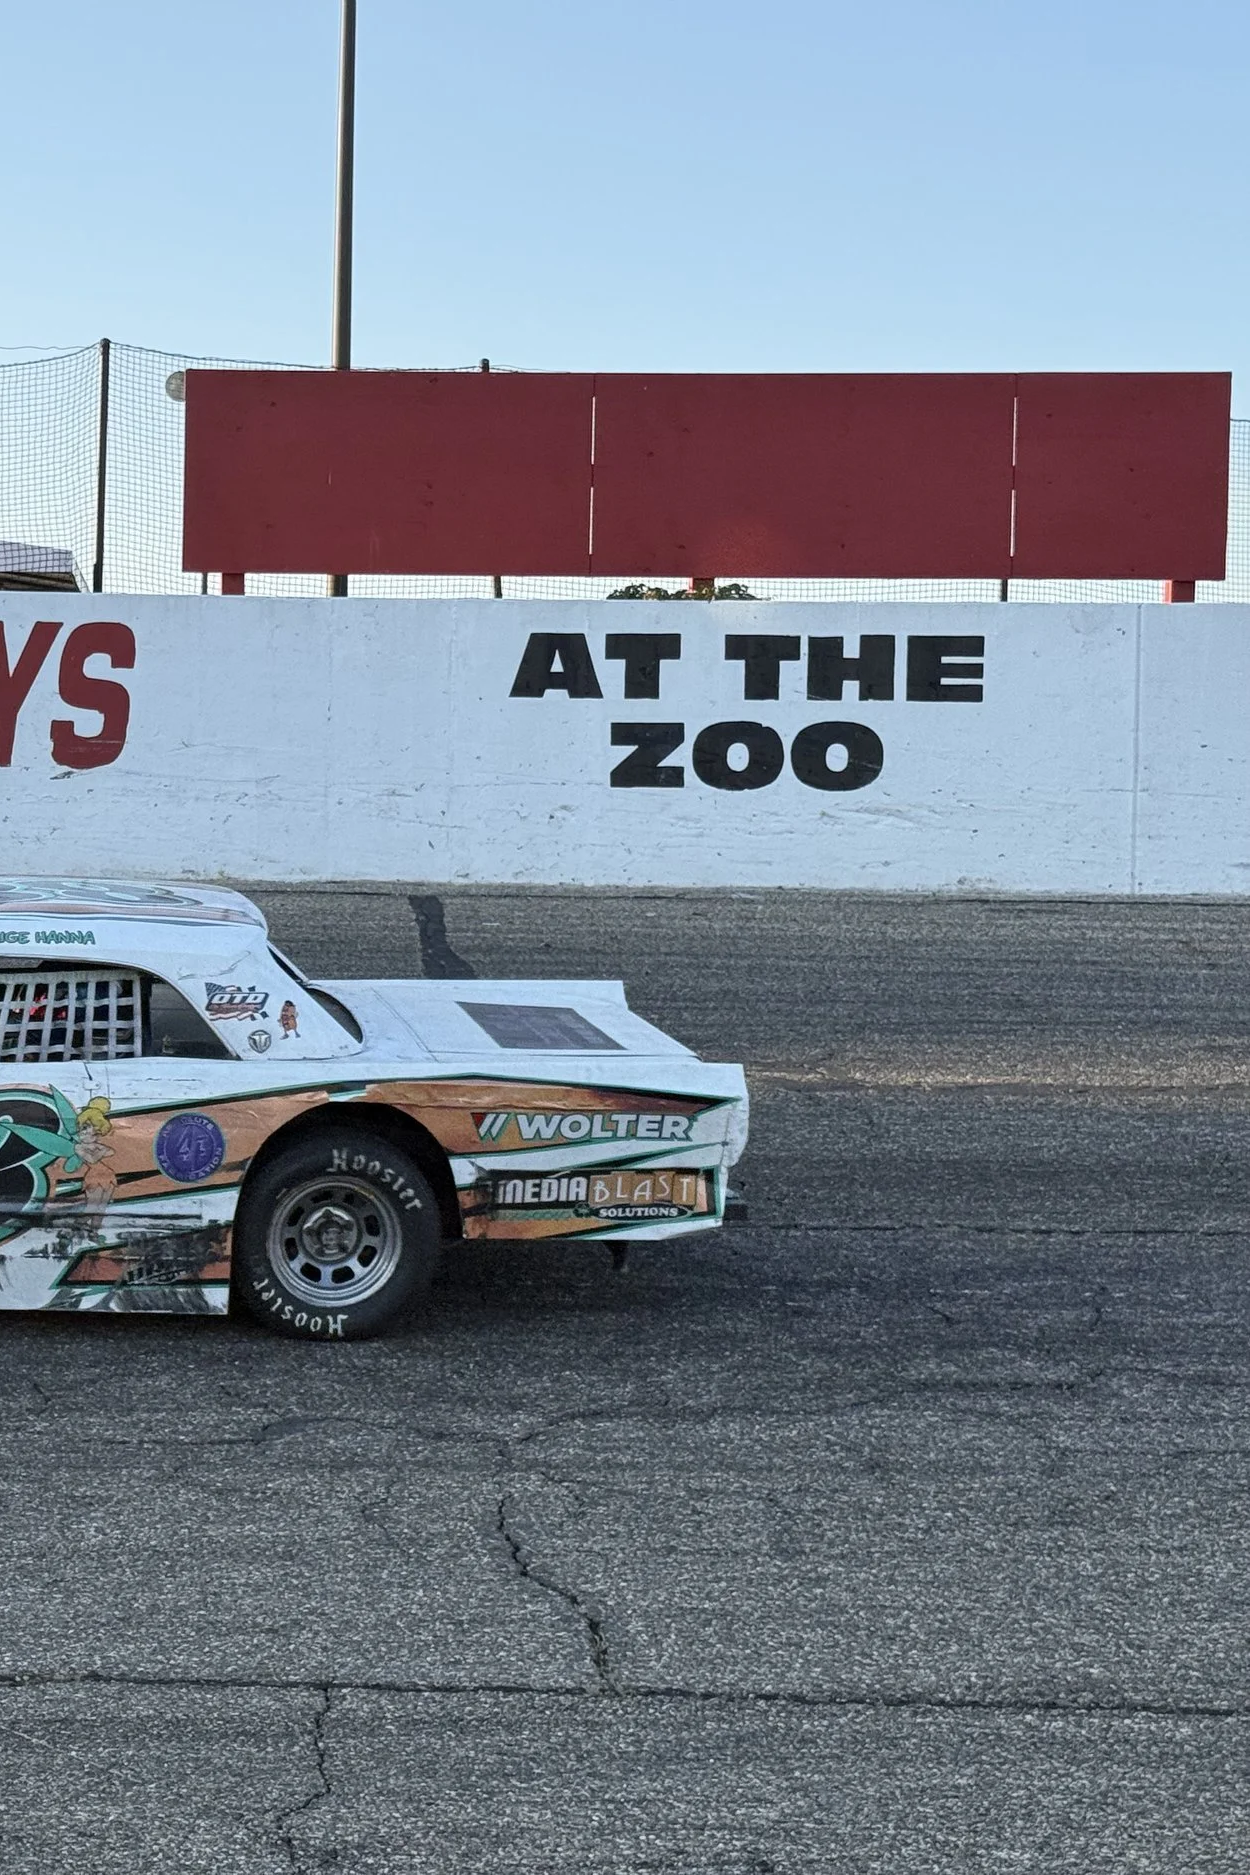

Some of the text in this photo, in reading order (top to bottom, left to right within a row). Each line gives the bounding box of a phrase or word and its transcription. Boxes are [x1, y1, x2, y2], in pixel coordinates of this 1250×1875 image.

[509, 632, 985, 703] AT THE
[610, 721, 884, 791] ZOO
[34, 930, 96, 945] HANNA
[515, 1112, 693, 1141] WOLTER
[599, 1206, 679, 1218] SOLUTIONS
